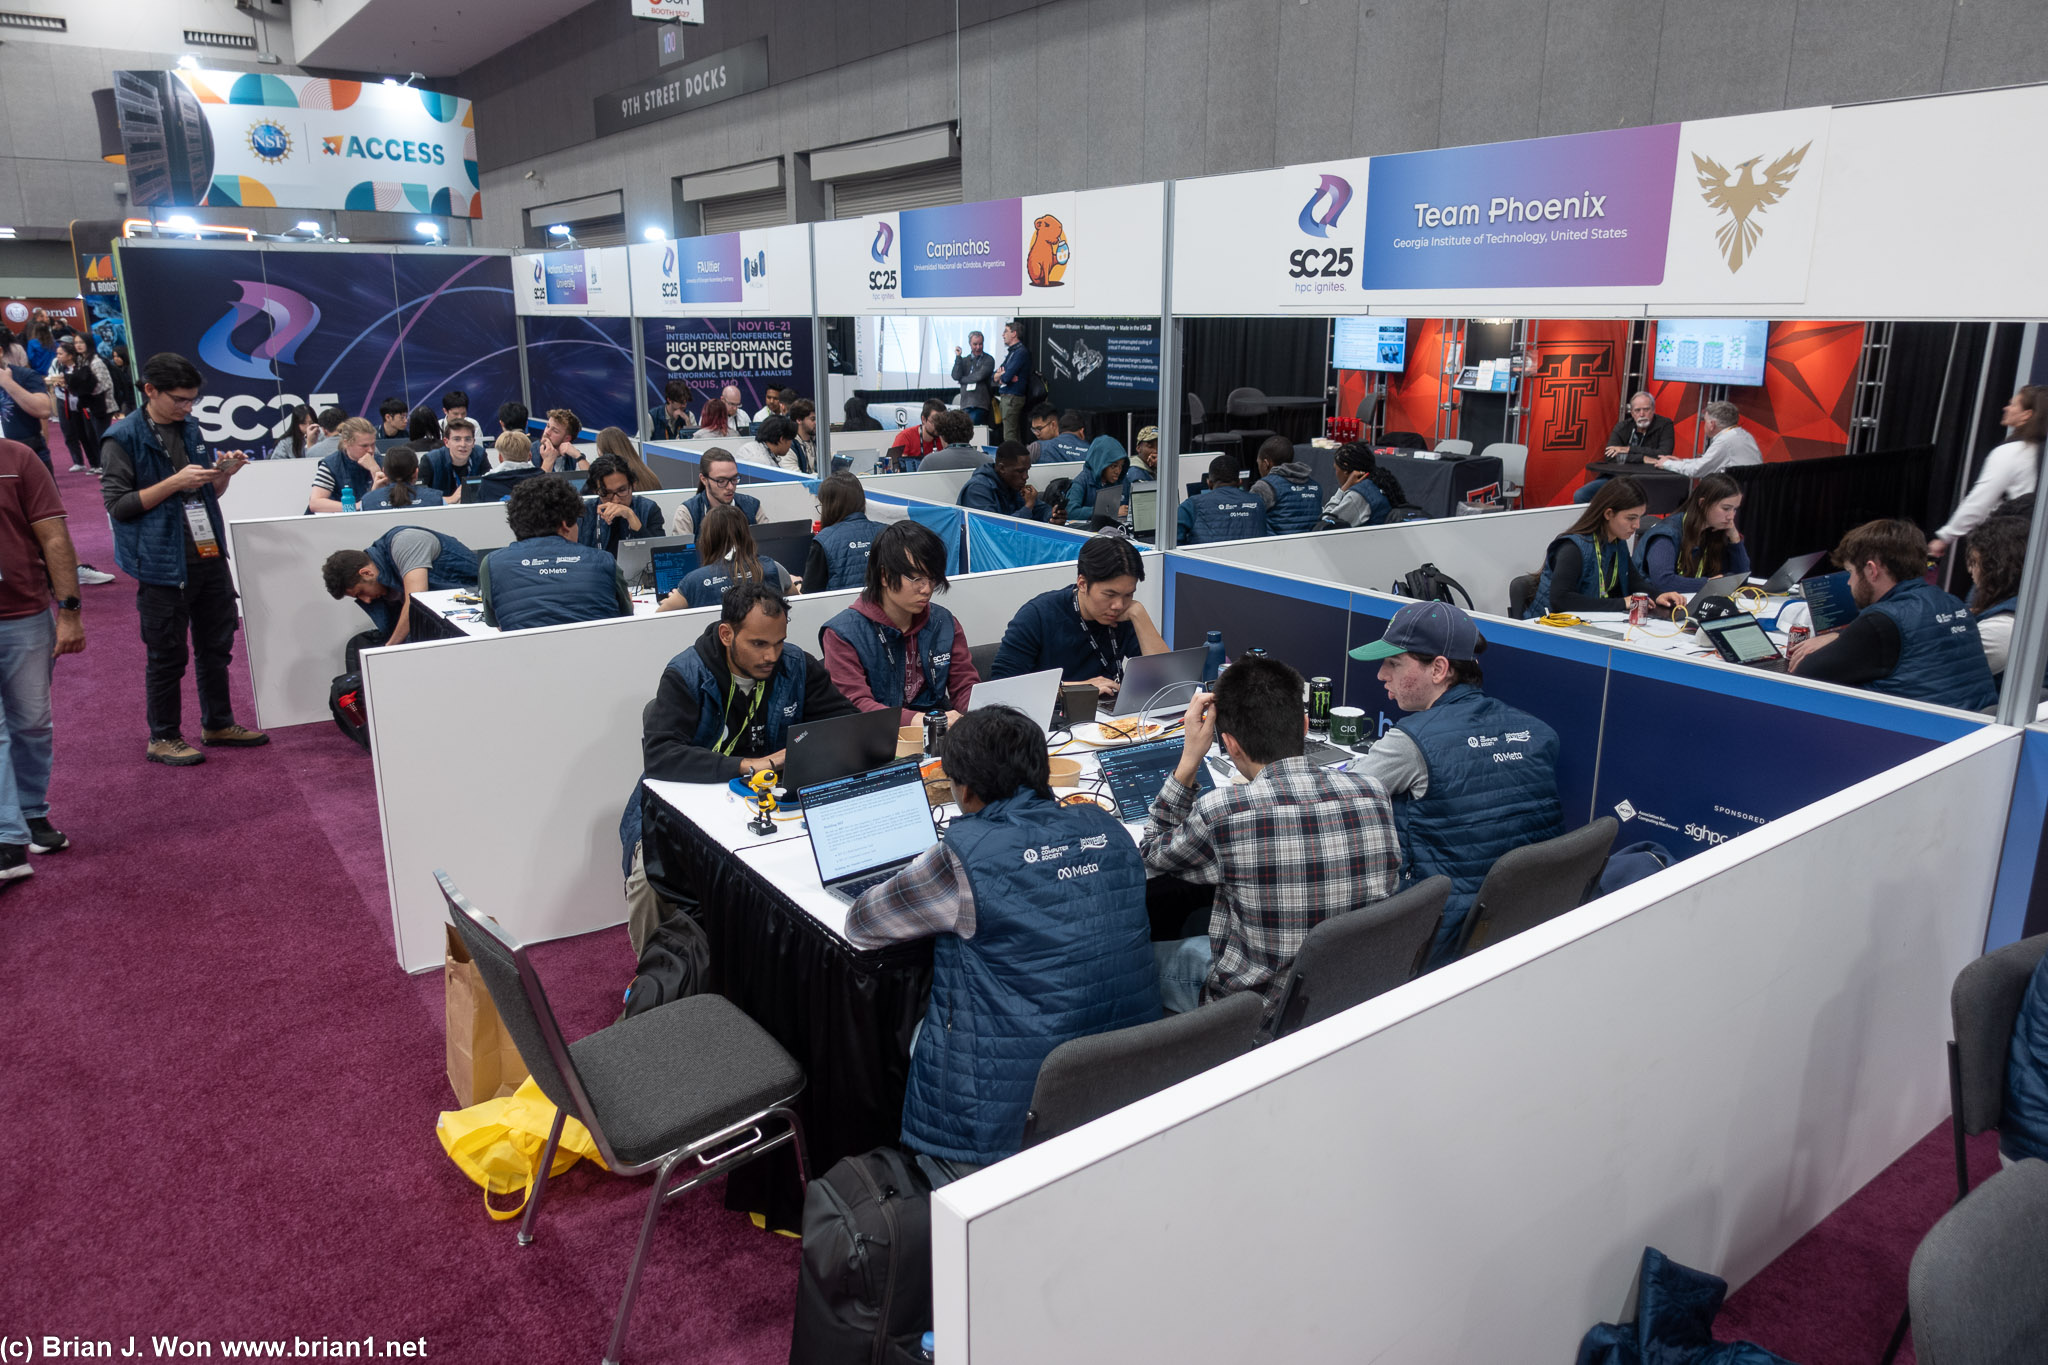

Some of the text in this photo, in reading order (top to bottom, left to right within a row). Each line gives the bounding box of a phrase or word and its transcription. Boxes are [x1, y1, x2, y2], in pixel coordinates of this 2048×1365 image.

[651, 7, 675, 16] BOOTH
[664, 31, 676, 54] 100
[621, 65, 727, 118] 9TH STREET DOCKS
[252, 133, 286, 150] NSF
[346, 135, 446, 166] ACCESS
[1414, 190, 1607, 228] Team Phoenix
[1393, 227, 1628, 250] Georgia Institute of Technology, United States
[926, 239, 991, 260] Carpinchos
[914, 263, 937, 272] Universidad
[938, 261, 956, 271] Nacional
[957, 262, 962, 270] de
[983, 259, 1005, 270] Argentina
[1288, 247, 1353, 278] SC25
[91, 281, 119, 292] A BOOST
[869, 270, 897, 290] SC25
[1294, 280, 1347, 294] hpc ignites.
[662, 282, 678, 297] SC25
[737, 321, 761, 331] NOV
[666, 332, 729, 340] INTERNATIONAL
[731, 331, 782, 339] CONFERENCE
[666, 340, 792, 352] HIGH PERFORMANCE
[665, 352, 793, 371] COMPUTING
[668, 371, 718, 379] NETWORKING,
[719, 370, 754, 379] STORAGE,
[761, 369, 792, 377] ANALYSIS
[686, 379, 739, 389] LOUIS, MO
[933, 652, 951, 664] SC25
[1340, 725, 1357, 733] CIQ
[1502, 752, 1523, 760] Meta
[1714, 805, 1765, 825] SPONSORED
[1041, 845, 1069, 856] COMPUTER
[1041, 852, 1063, 861] SOCIETY
[1072, 863, 1100, 877] Meta
